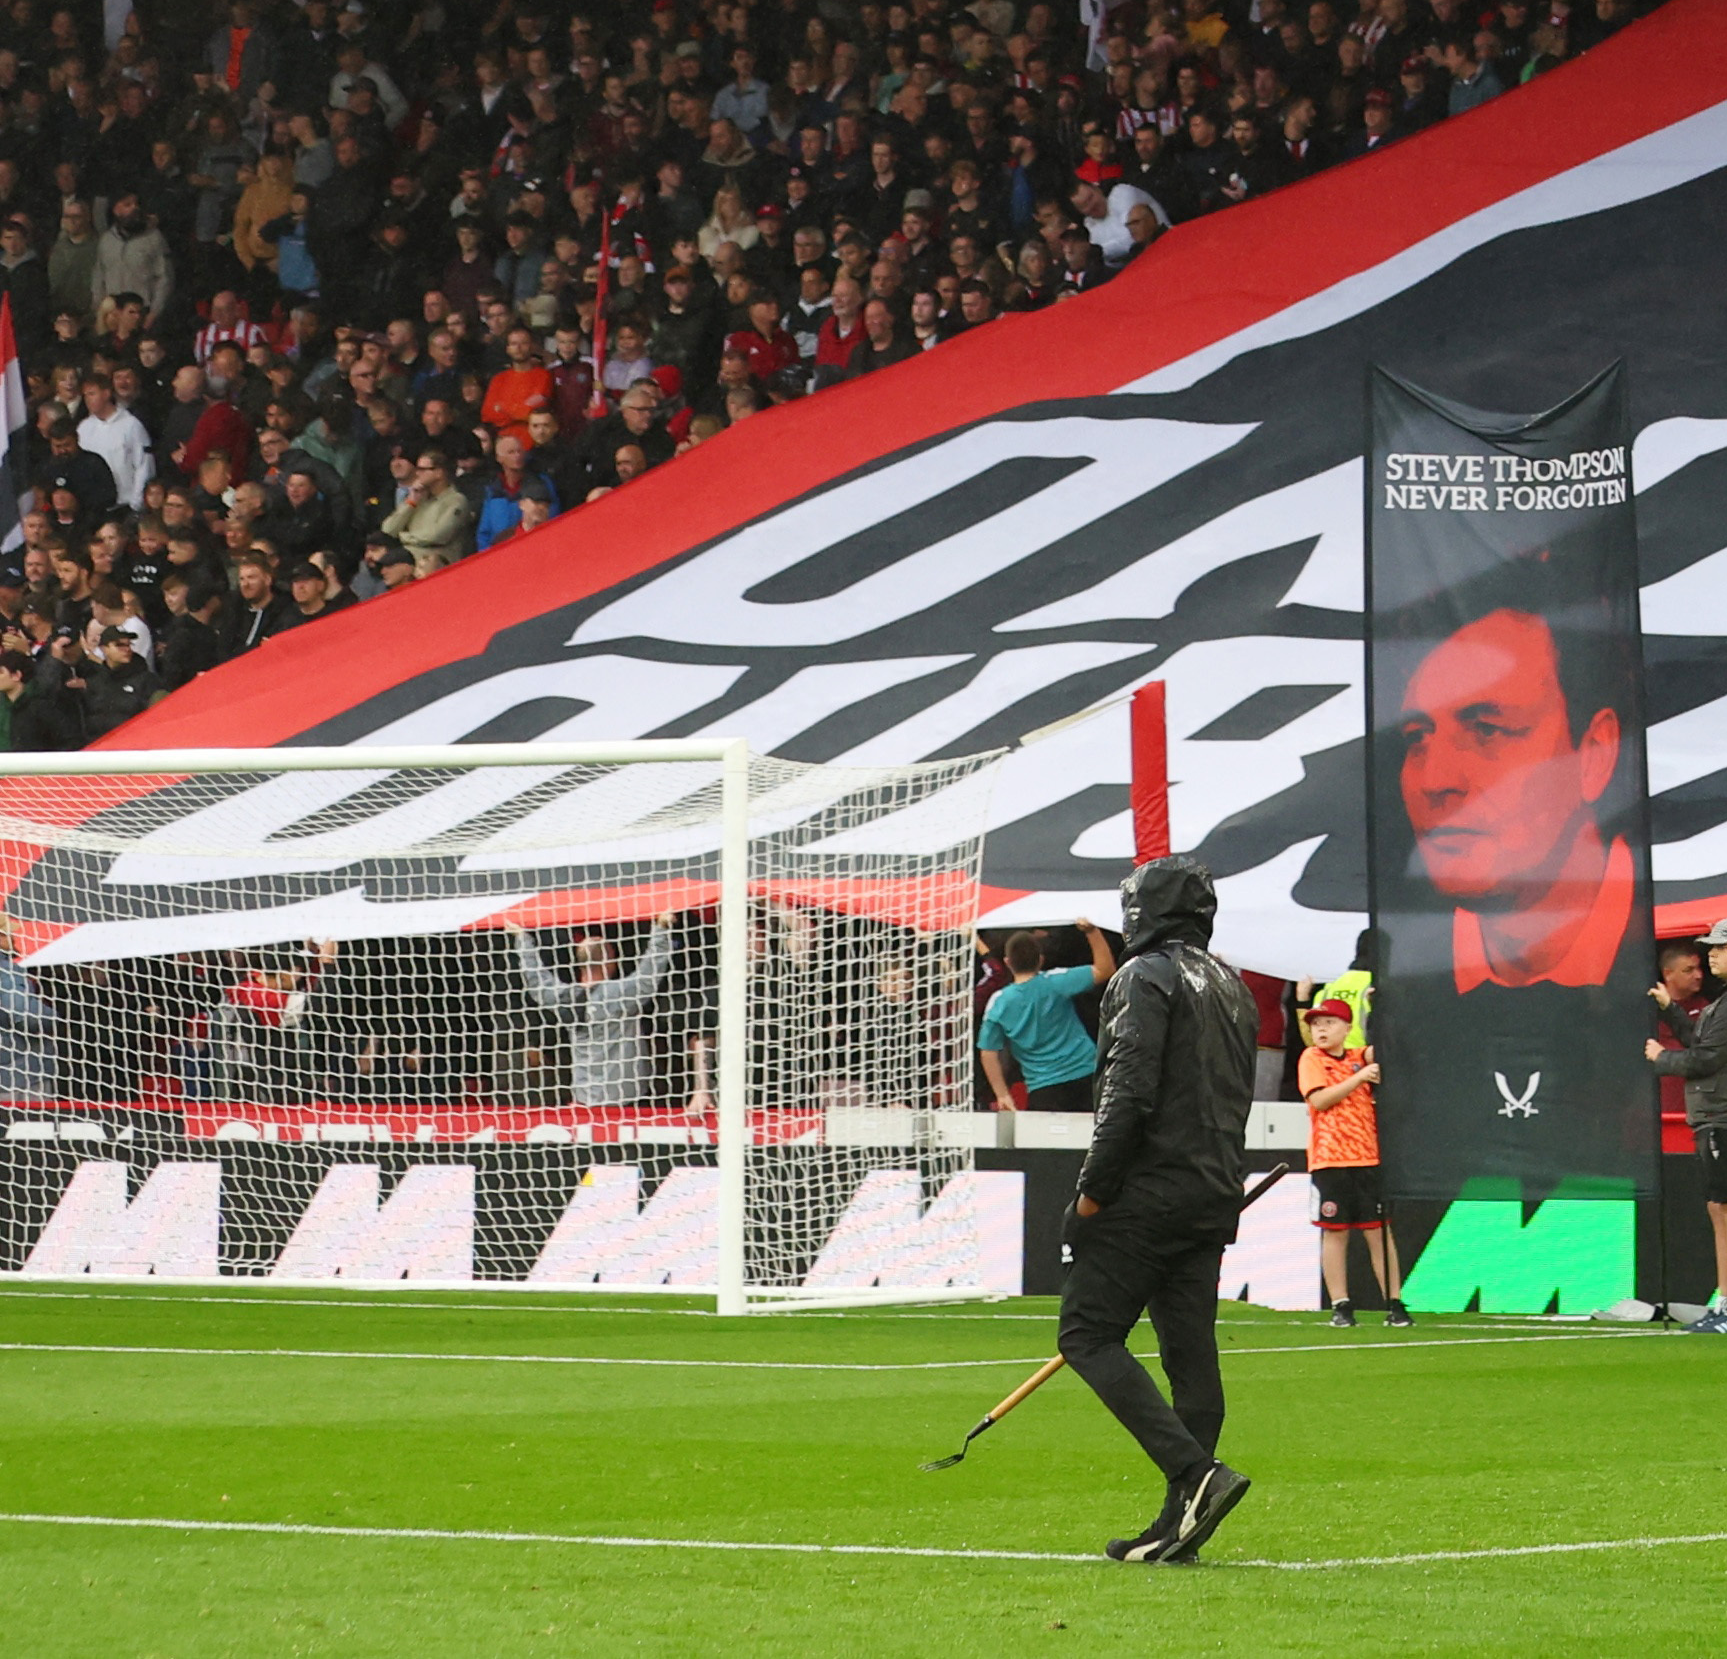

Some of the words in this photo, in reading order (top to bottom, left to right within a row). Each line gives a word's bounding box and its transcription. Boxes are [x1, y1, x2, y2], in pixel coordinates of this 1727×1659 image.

[1385, 454, 1484, 483] STEVE
[1490, 446, 1625, 483] THOMPSON
[1384, 485, 1489, 511] NEVER
[1496, 478, 1626, 511] FORGOTTEN
